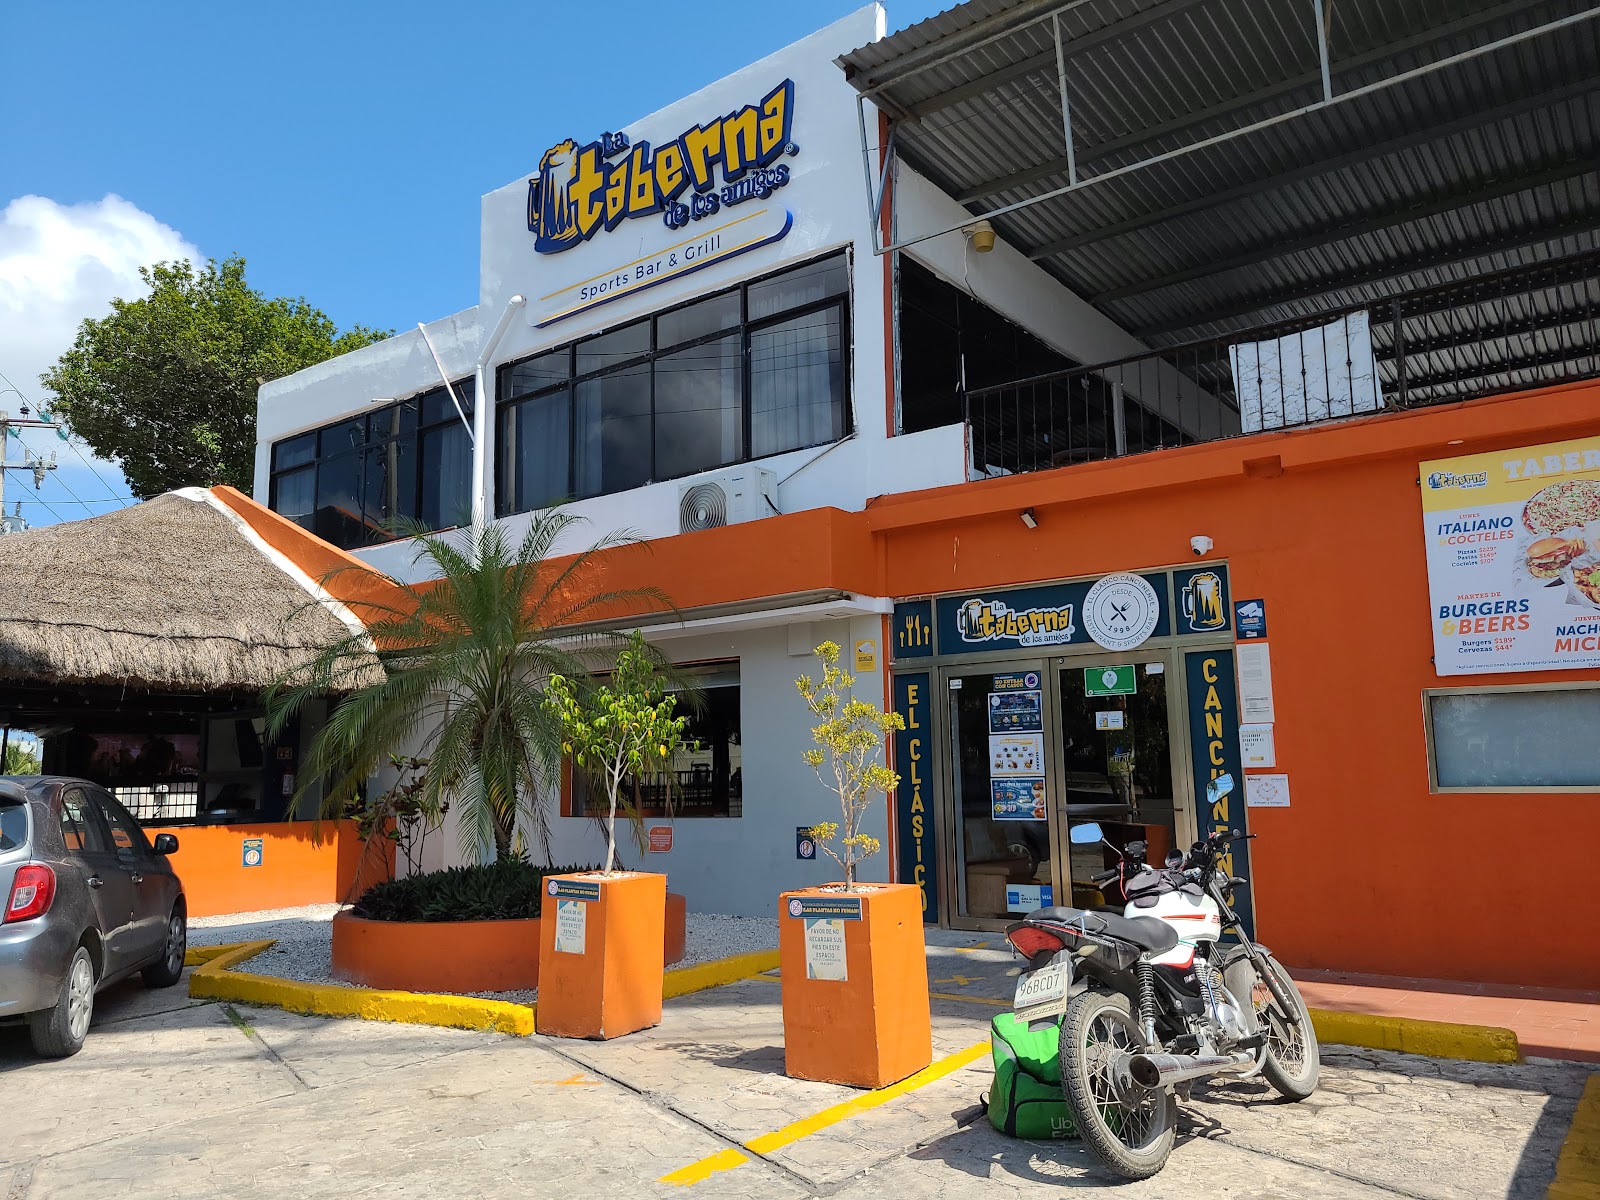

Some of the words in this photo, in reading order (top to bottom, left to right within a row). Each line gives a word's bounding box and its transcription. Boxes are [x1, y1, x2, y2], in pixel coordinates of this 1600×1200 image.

[600, 131, 629, 158] La
[567, 80, 792, 239] taberna
[663, 200, 690, 230] de
[690, 192, 720, 221] los
[720, 164, 790, 207] amigos
[580, 273, 629, 300] Sports
[635, 260, 662, 280] Bar
[668, 253, 678, 267] &
[684, 234, 720, 260] Grill
[1503, 450, 1600, 479] TABER
[1439, 472, 1486, 488] taberna
[1438, 516, 1513, 535] ITALIANO
[1087, 596, 1095, 604] EL
[1120, 575, 1156, 606] CANCUNENSE
[1111, 588, 1133, 597] DESDE
[1457, 592, 1489, 600] MARTES
[994, 602, 1004, 611] La
[1439, 598, 1530, 619] BURGERS
[978, 606, 1070, 638] taberna
[1085, 614, 1116, 647] RESTAURANT
[1123, 631, 1147, 647] SPORTS
[1145, 616, 1155, 631] BAR
[1108, 625, 1131, 634] 1998
[1556, 624, 1600, 636] NACH
[1022, 634, 1031, 643] de
[1032, 634, 1042, 643] los
[1044, 632, 1069, 642] amigos
[1461, 638, 1492, 646] Burgers
[1555, 636, 1600, 653] MIC
[907, 684, 919, 729] EL
[1020, 973, 1060, 997] 96BCD7
